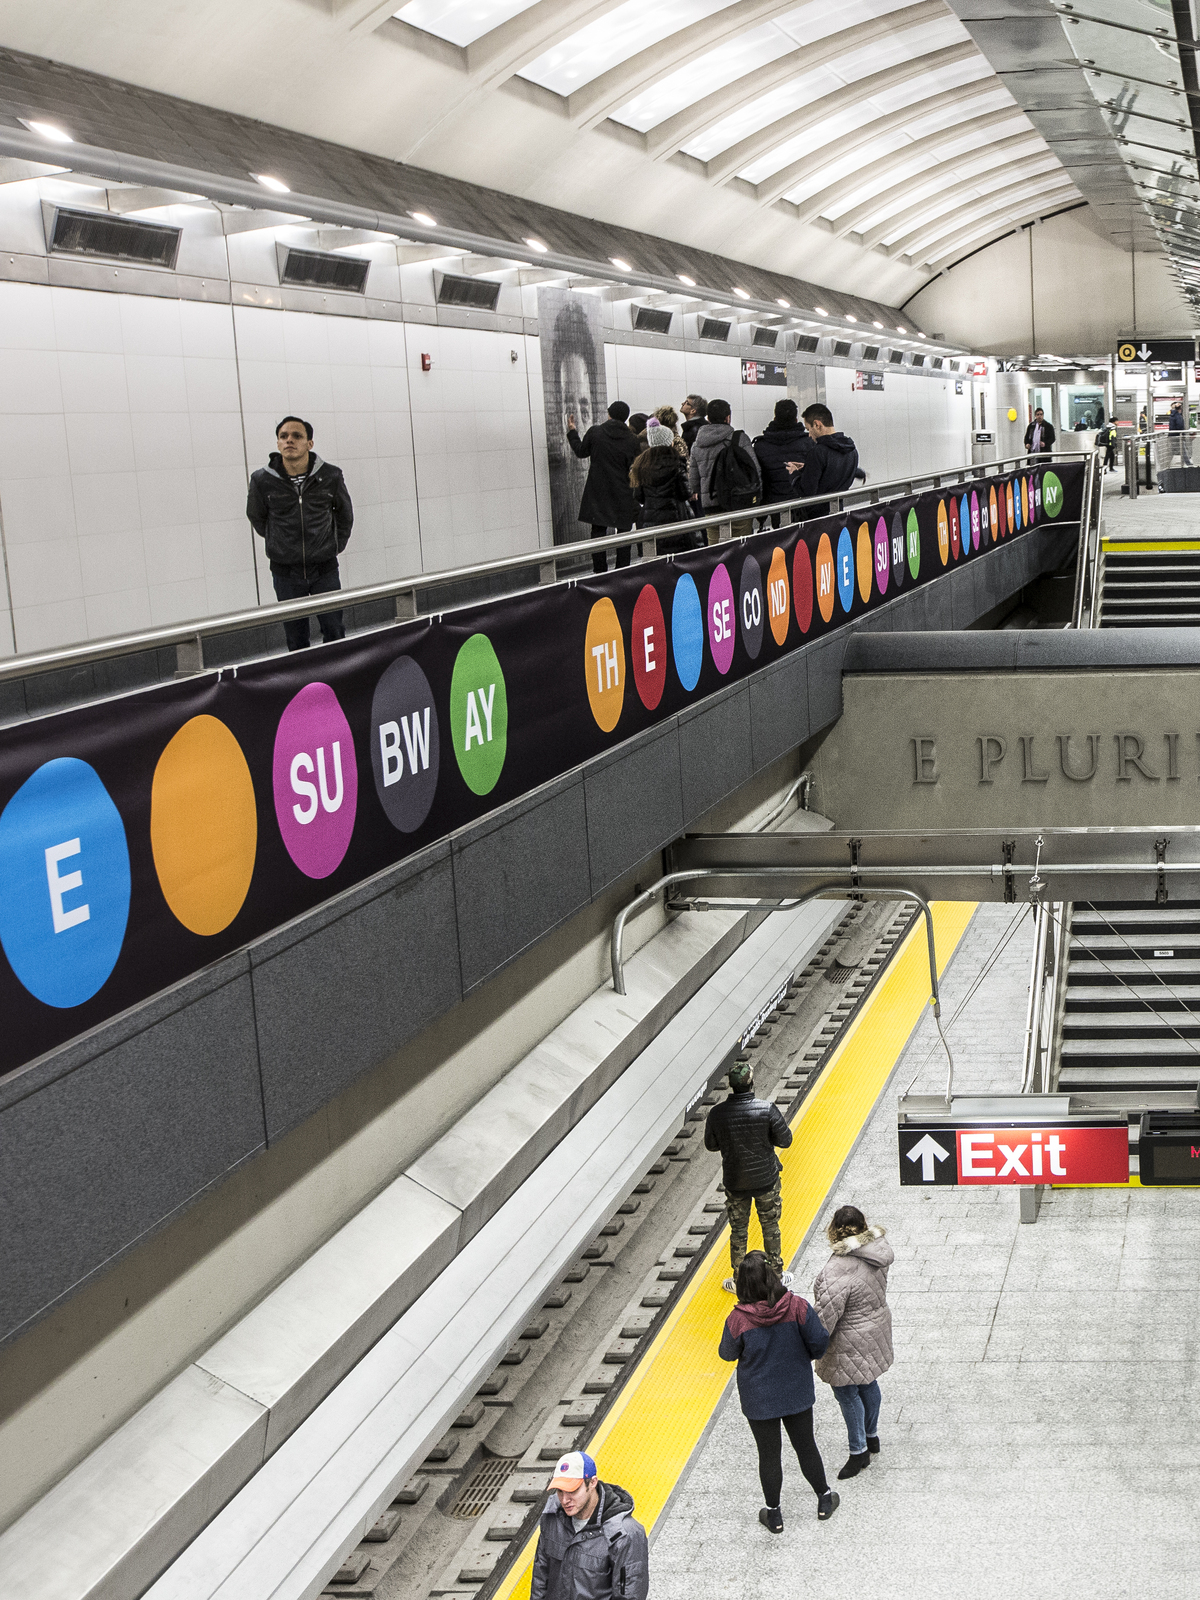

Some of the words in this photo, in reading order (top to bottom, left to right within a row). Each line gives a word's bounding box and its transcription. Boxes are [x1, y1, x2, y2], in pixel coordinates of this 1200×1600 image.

[1122, 348, 1132, 357] Q
[953, 518, 957, 540] E
[1046, 486, 1057, 504] AY
[592, 640, 619, 693] TH
[644, 626, 656, 672] E
[713, 599, 732, 643] SE
[744, 588, 760, 630] CO
[771, 579, 786, 617] ND
[820, 562, 830, 596] AV
[843, 556, 849, 586] E
[877, 542, 887, 572] SU
[893, 536, 903, 565] BW
[910, 531, 917, 558] AY
[909, 736, 940, 784] E
[45, 838, 90, 934] E
[290, 741, 345, 825] SU
[379, 707, 431, 787] BW
[464, 684, 496, 751] AY
[960, 1133, 1067, 1177] Exit
